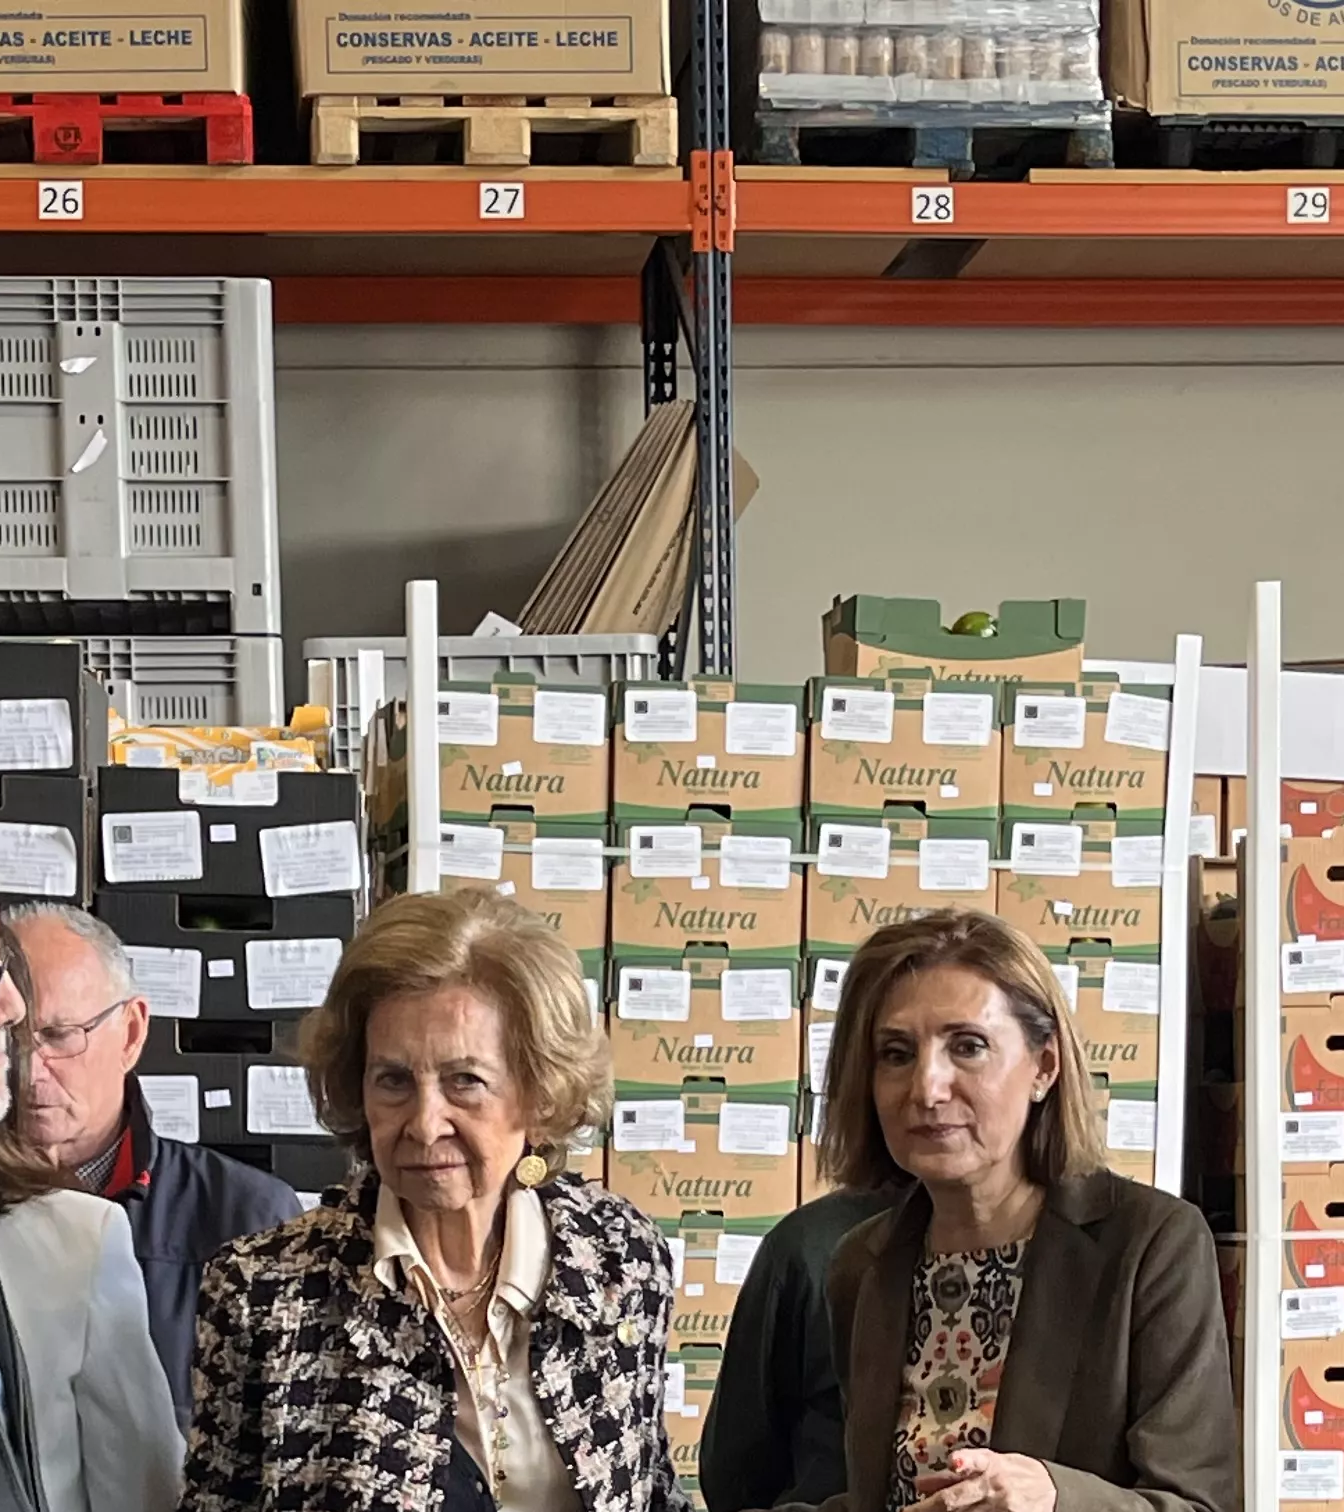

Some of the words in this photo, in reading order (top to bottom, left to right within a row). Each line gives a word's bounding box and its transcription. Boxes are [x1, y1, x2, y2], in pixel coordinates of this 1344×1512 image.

[1296, 9, 1321, 26] DE
[42, 30, 113, 47] ACEITE
[128, 29, 193, 46] LECHE
[335, 31, 453, 48] CONSERVAS
[468, 31, 539, 47] ACEITE
[555, 30, 619, 47] LECHE
[1187, 55, 1299, 72] CONSERVAS
[41, 187, 80, 215] 26
[483, 187, 521, 215] 27
[915, 193, 952, 221] 28
[1292, 192, 1328, 218] 29
[459, 763, 566, 794] Natura
[655, 760, 761, 789] Natura
[854, 758, 958, 787] Natura
[1046, 759, 1146, 789] Natura
[653, 901, 757, 930] Natura
[652, 1036, 755, 1064] Natura
[1084, 1039, 1139, 1063] tura
[650, 1171, 753, 1198] Natura
[673, 1310, 730, 1332] atur
